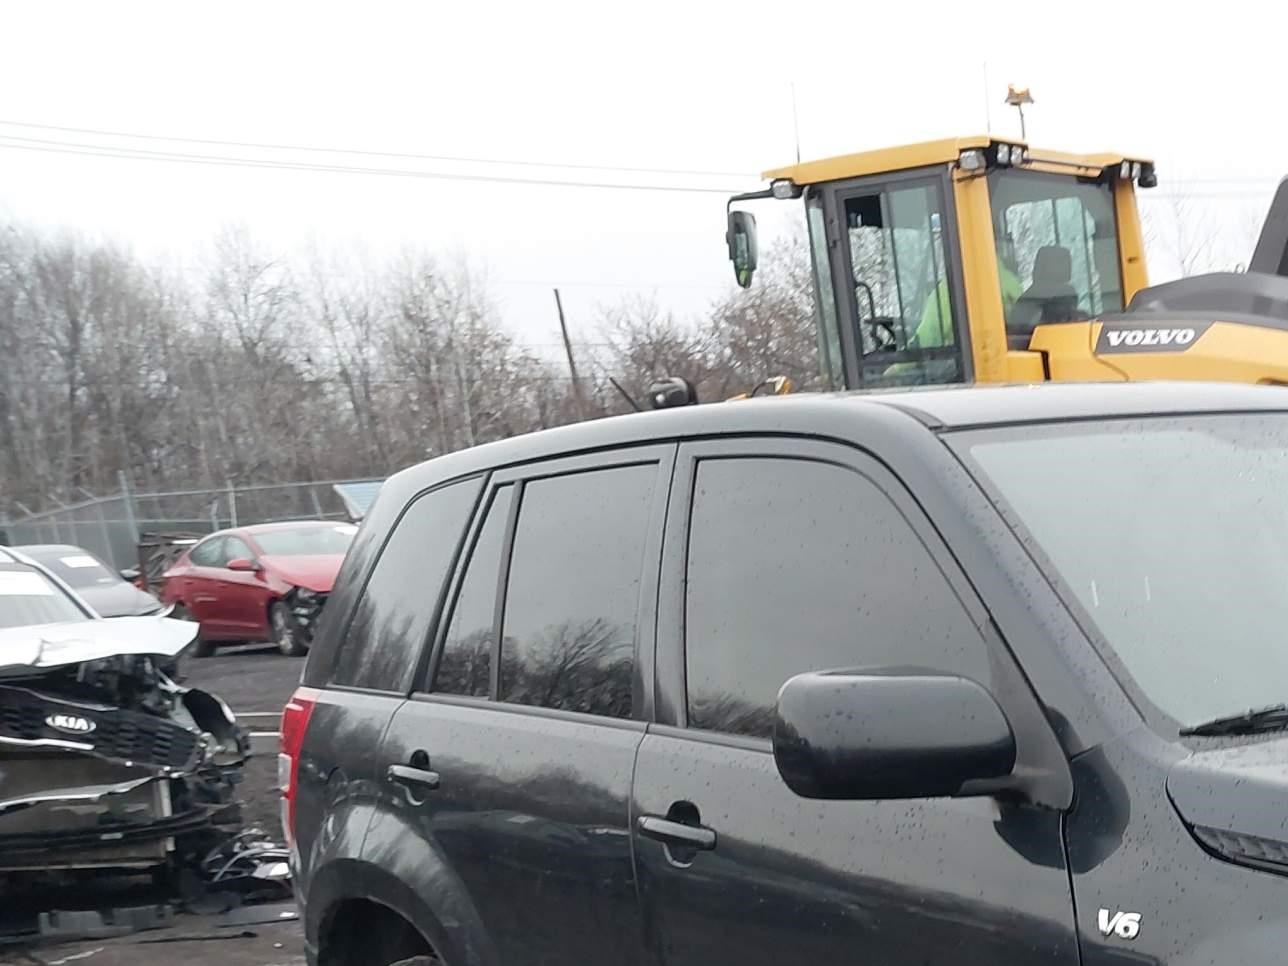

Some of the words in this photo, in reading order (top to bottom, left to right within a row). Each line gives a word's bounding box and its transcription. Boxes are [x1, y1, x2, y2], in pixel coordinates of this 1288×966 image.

[1106, 328, 1195, 347] VOLVO
[54, 715, 89, 731] KIA
[1098, 908, 1142, 939] V6
